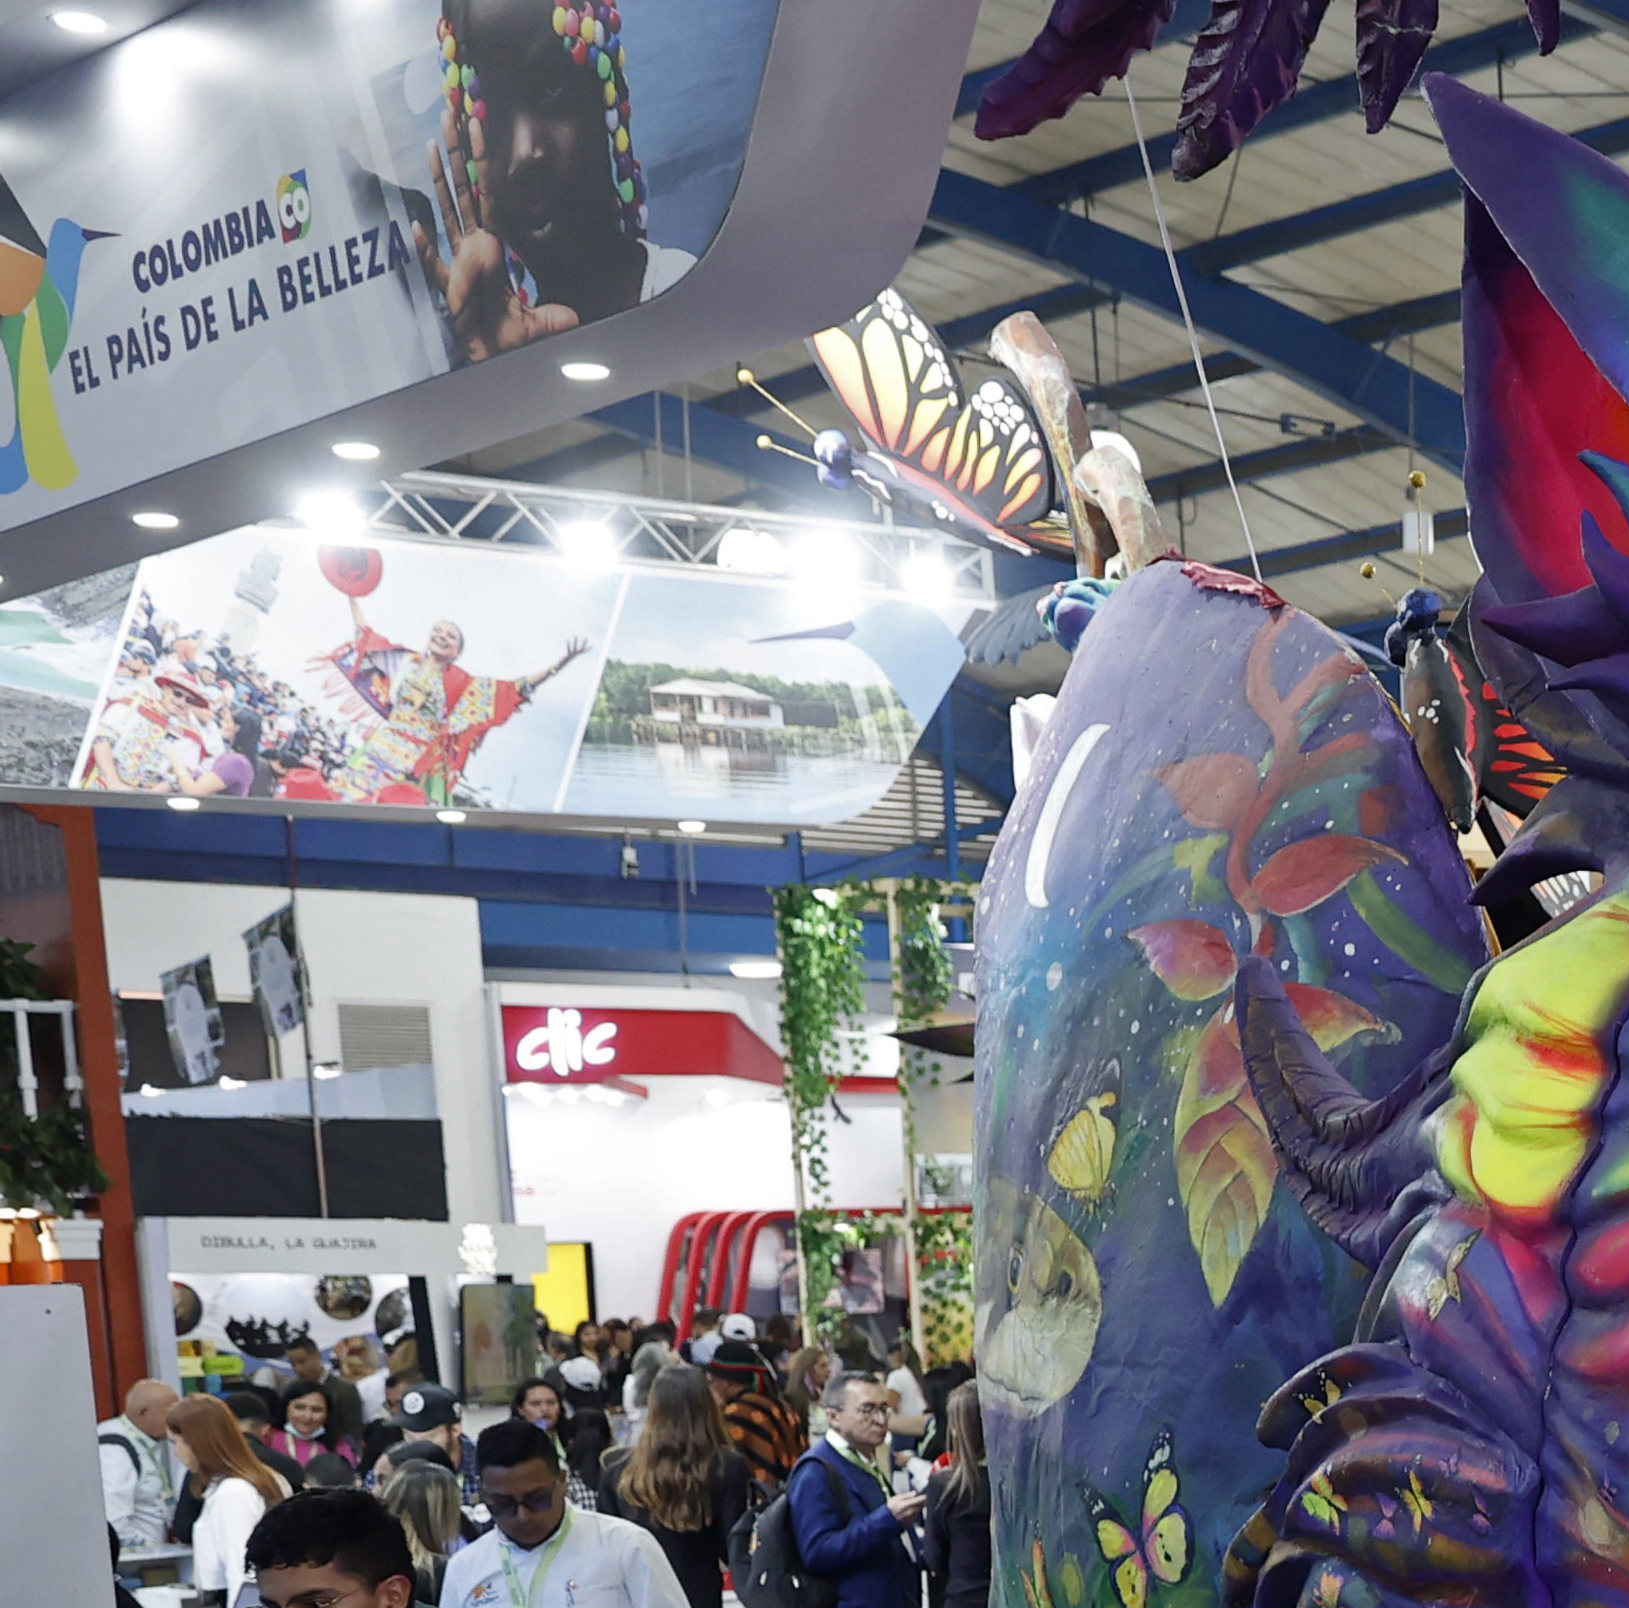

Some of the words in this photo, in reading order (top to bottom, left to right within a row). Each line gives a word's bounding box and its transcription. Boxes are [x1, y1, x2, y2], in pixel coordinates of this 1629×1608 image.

[132, 199, 276, 294] COLOMBIA
[68, 345, 101, 395] EL
[106, 306, 171, 380] PAÍS
[179, 295, 219, 352] DE
[227, 278, 270, 333] LA
[276, 219, 412, 314] BELLEZA
[516, 1007, 618, 1077] clic
